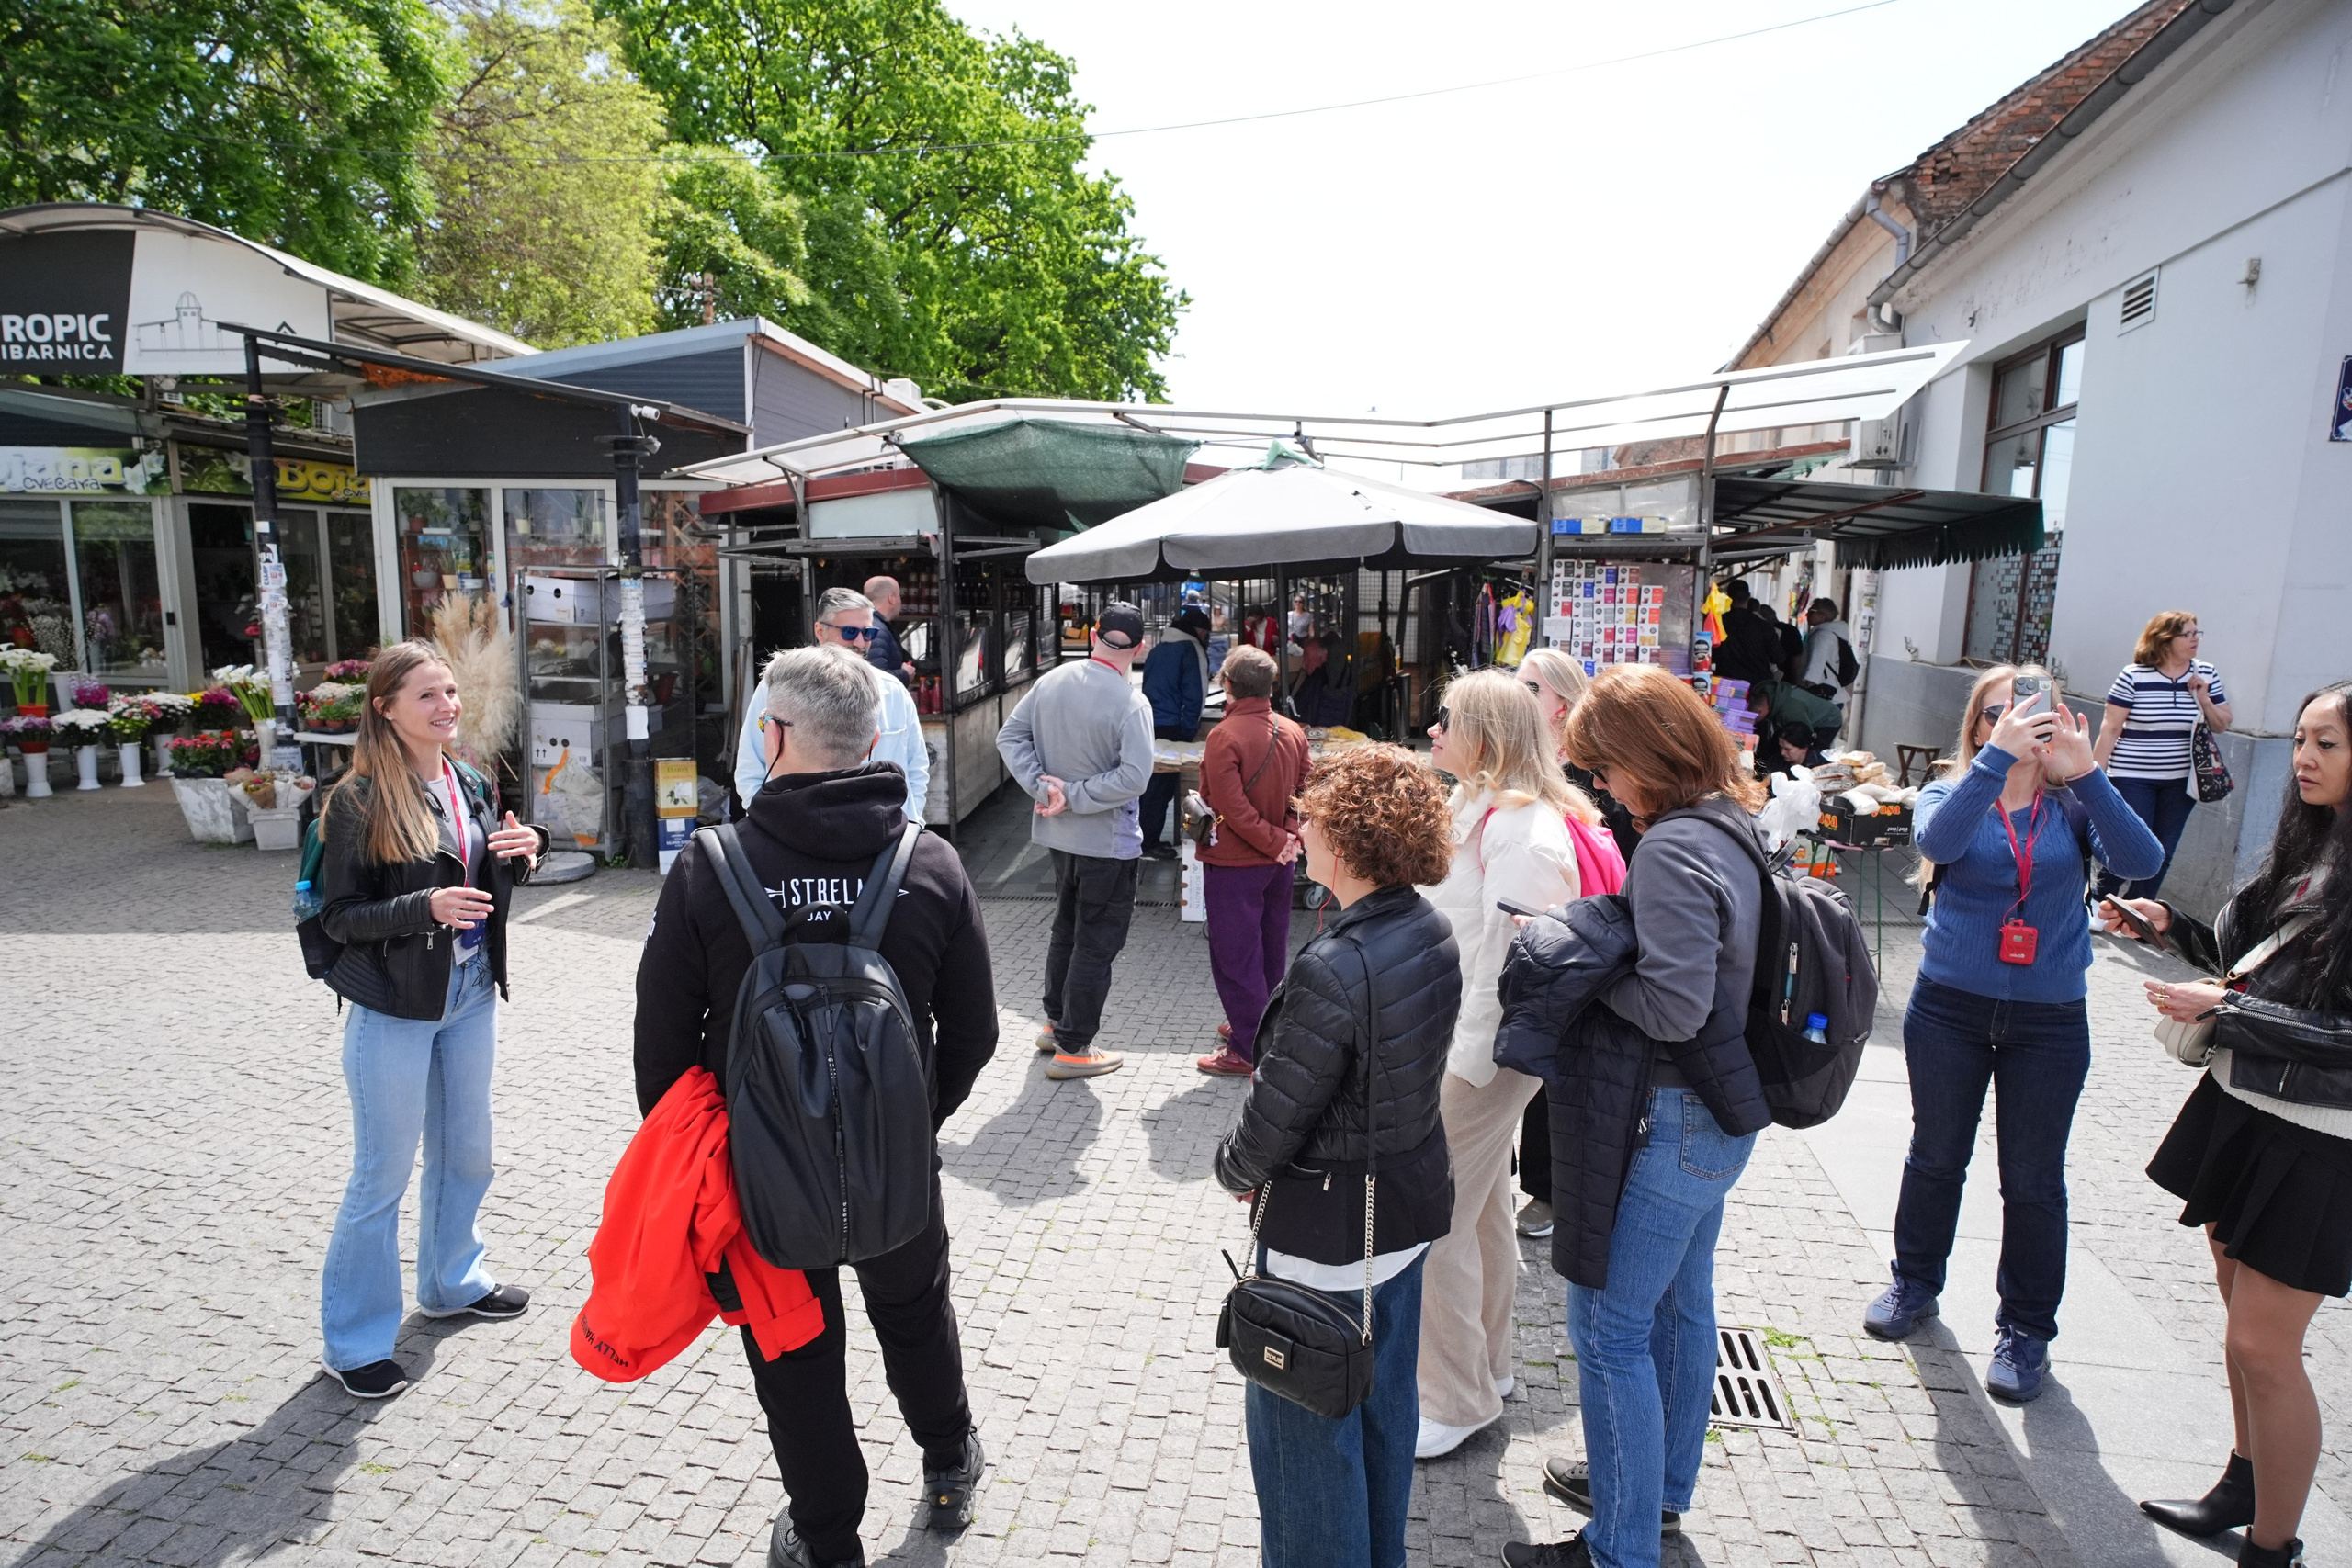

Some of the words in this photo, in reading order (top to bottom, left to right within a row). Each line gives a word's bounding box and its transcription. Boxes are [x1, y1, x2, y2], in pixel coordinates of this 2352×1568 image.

[0, 313, 112, 343] ROPIC
[0, 344, 114, 360] IBARNICA
[790, 878, 864, 906] STREL
[807, 910, 831, 922] JAY
[594, 1340, 629, 1368] HELLY
